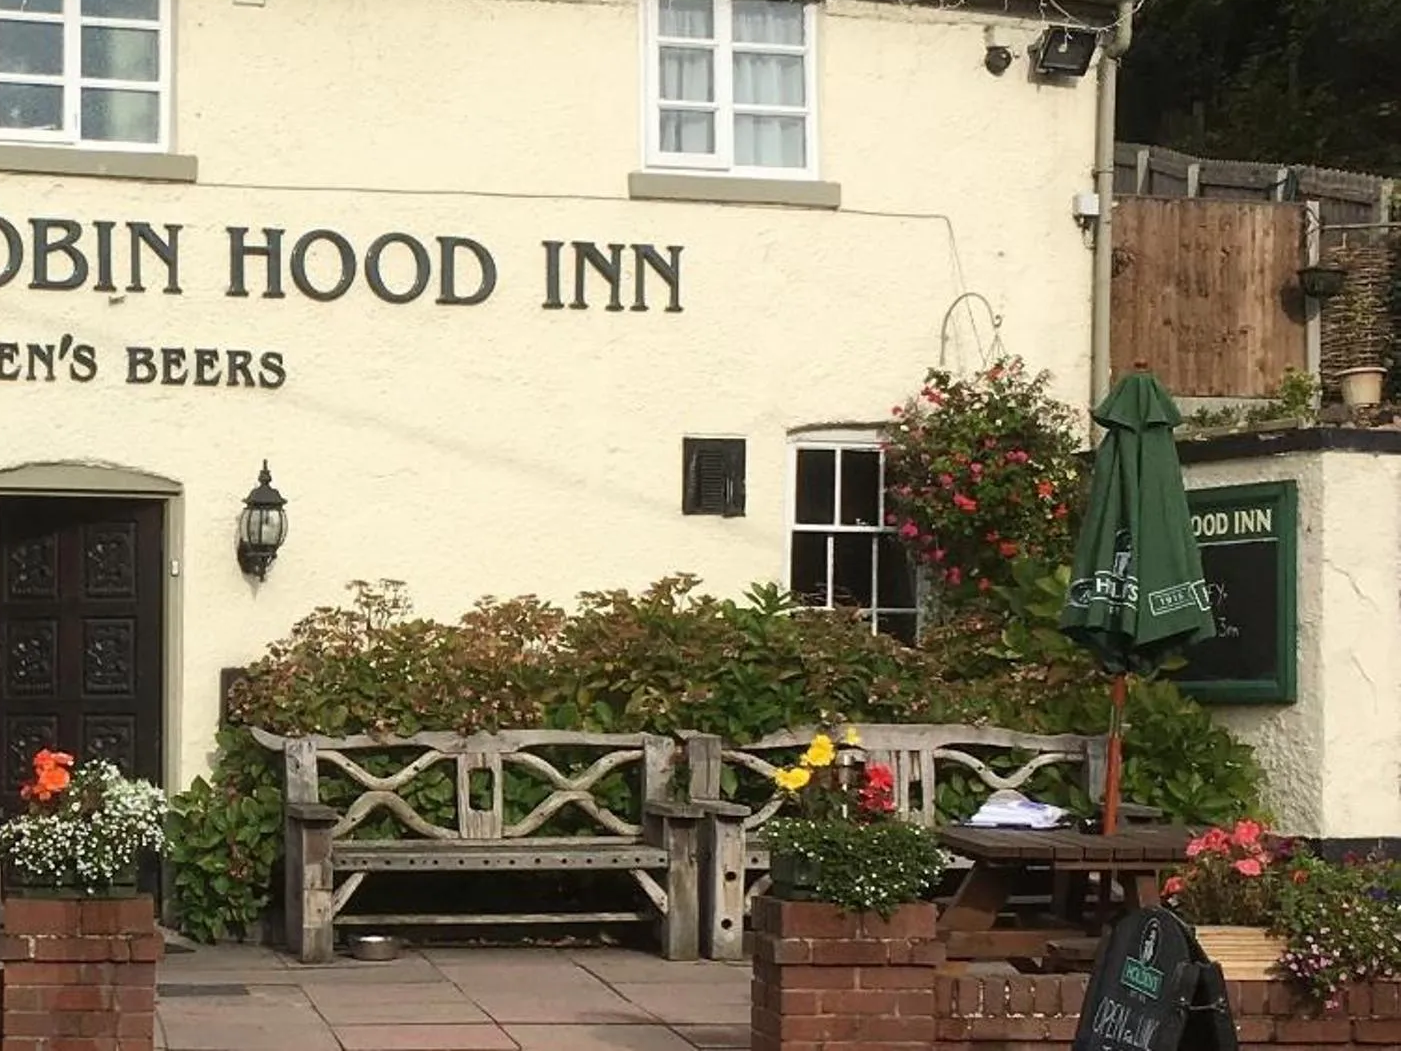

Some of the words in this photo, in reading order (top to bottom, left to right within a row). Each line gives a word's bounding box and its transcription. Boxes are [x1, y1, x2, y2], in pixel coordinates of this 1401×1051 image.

[225, 226, 497, 306] HOOD
[542, 240, 684, 313] INN
[125, 347, 286, 390] BEERS
[1192, 513, 1229, 537] OOD
[1234, 508, 1273, 534] INN
